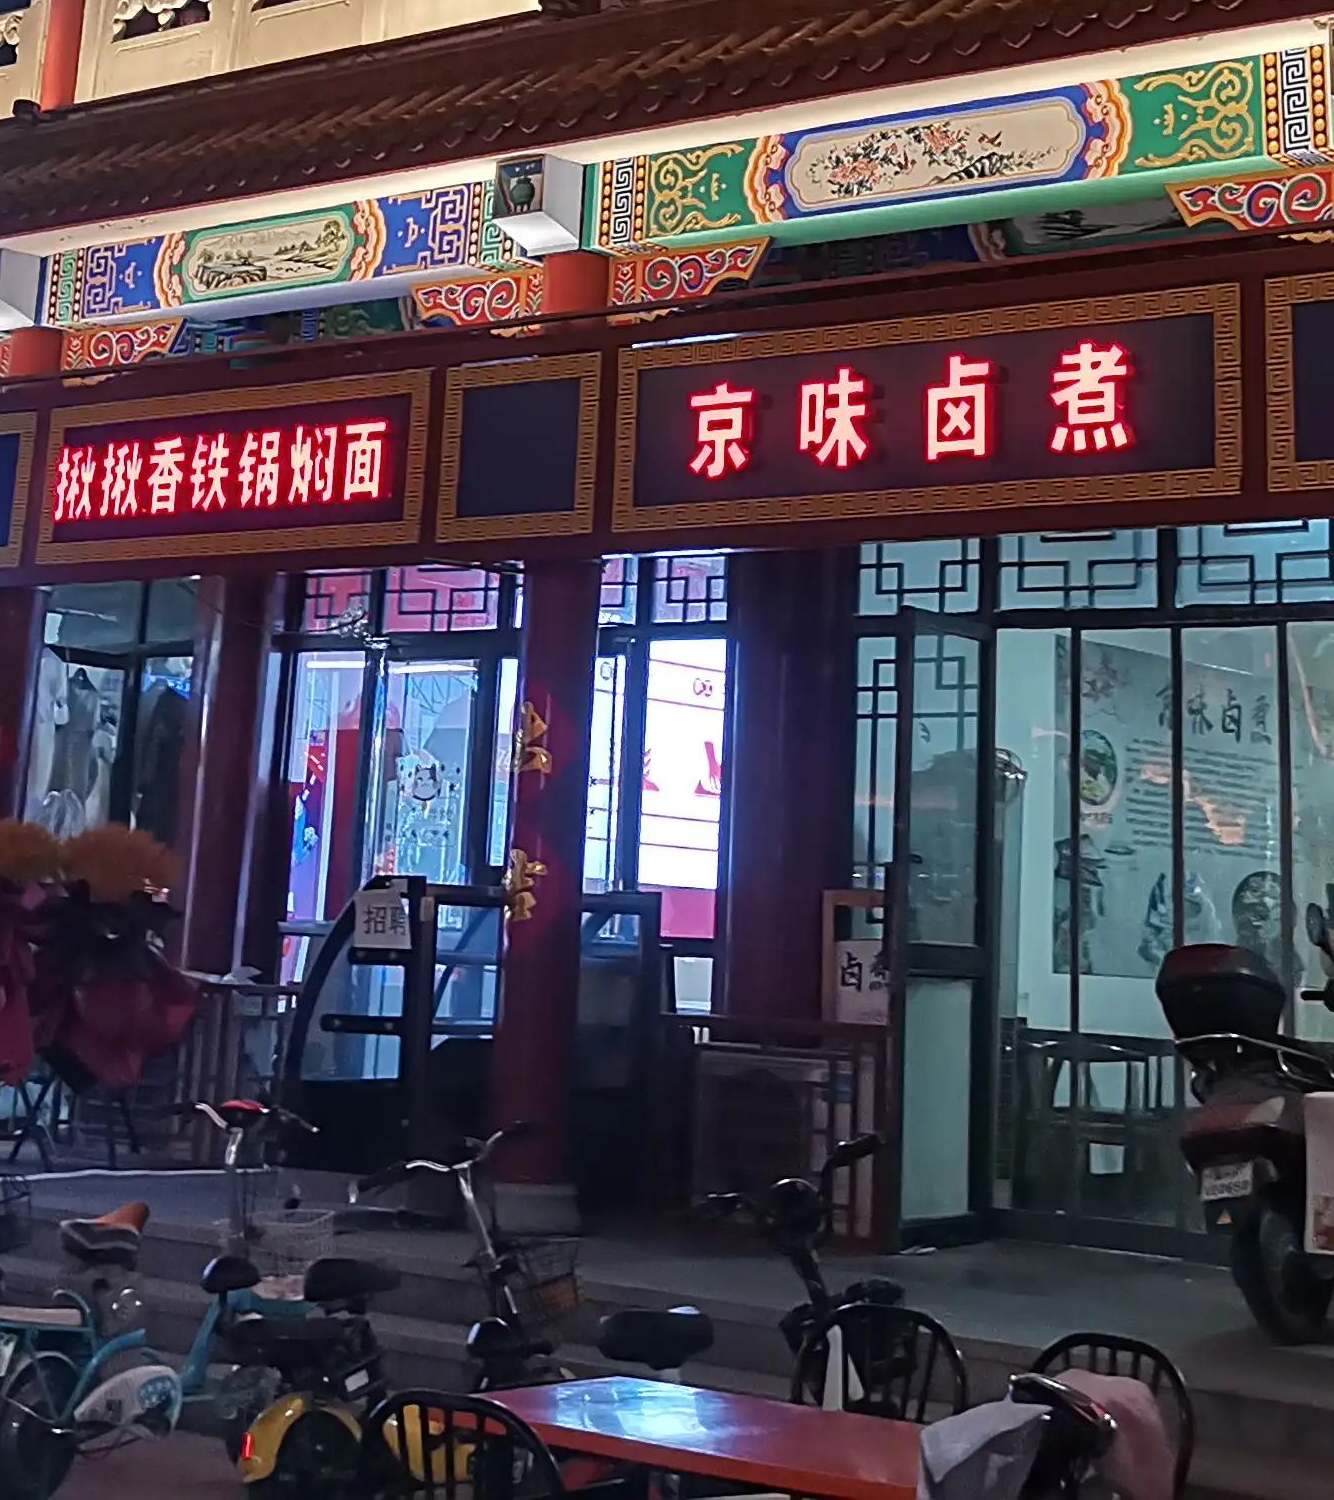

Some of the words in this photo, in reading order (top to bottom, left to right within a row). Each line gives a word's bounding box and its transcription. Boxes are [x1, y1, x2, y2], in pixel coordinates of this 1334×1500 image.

[689, 340, 1132, 478] 京味卤煮
[363, 905, 406, 935] 招聘
